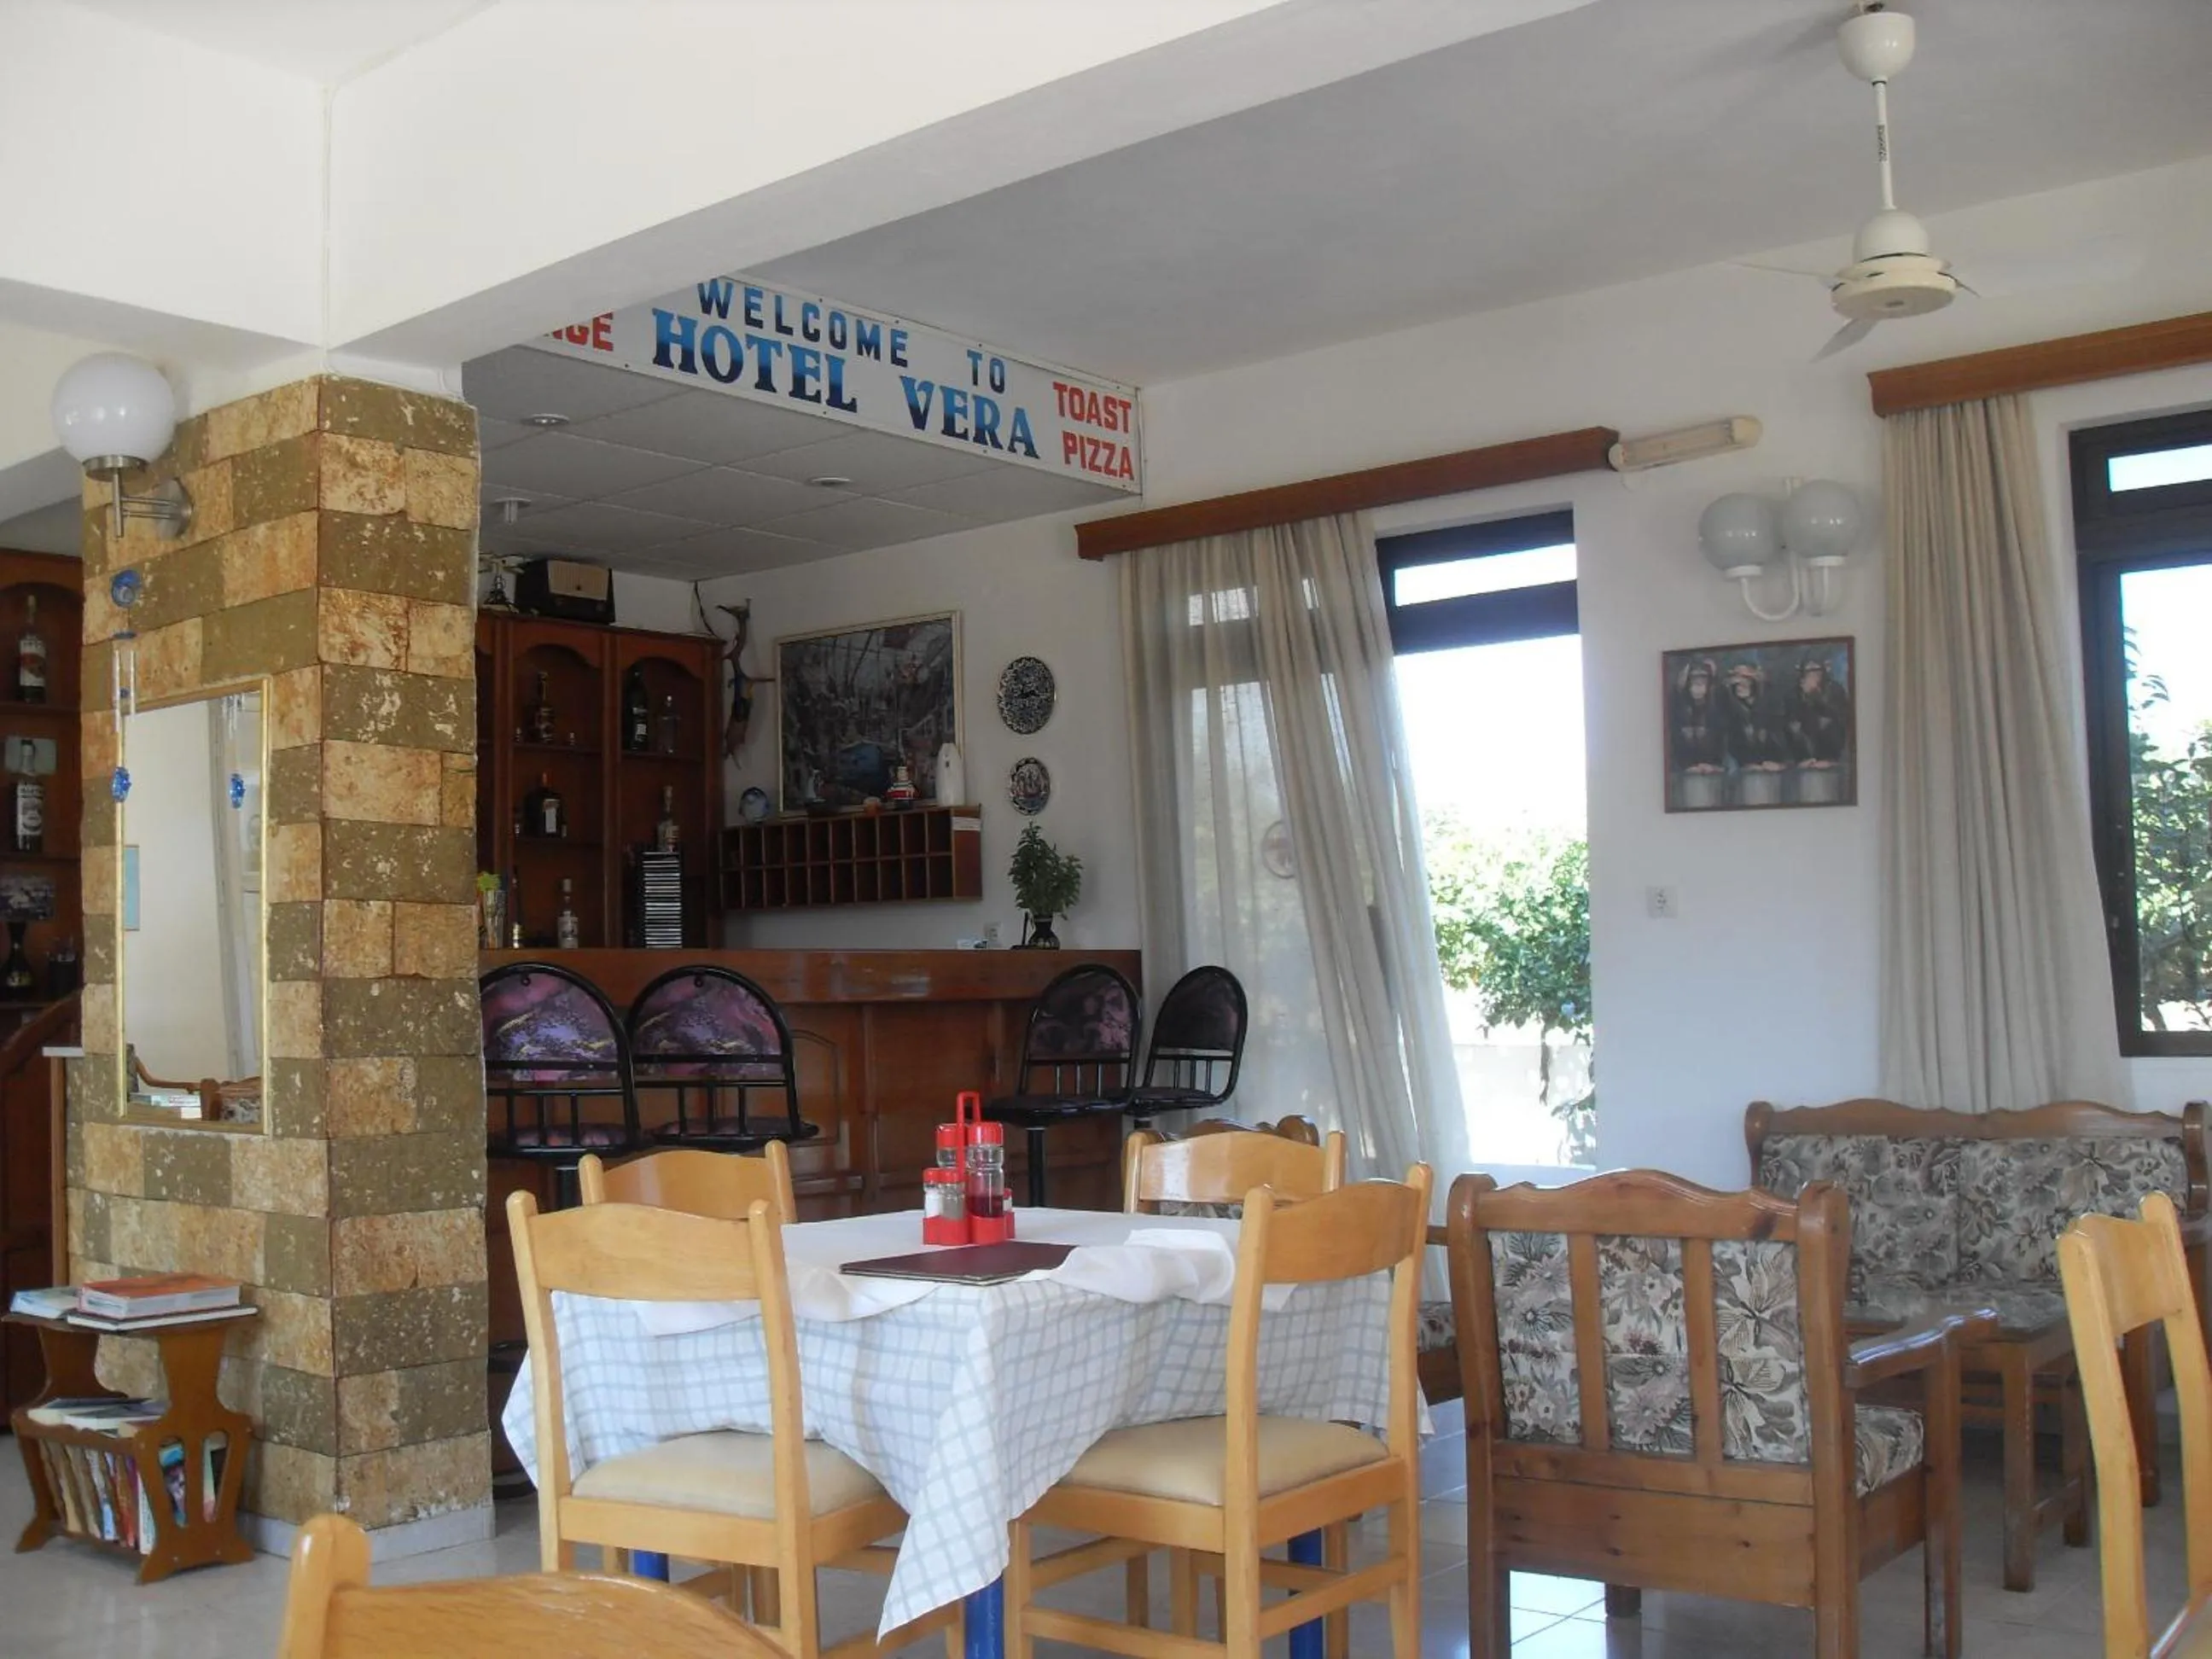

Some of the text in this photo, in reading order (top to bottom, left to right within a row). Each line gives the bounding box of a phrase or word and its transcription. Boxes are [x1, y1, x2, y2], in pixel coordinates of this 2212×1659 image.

[697, 277, 1005, 393] WELCOME TO
[652, 307, 1040, 459] HOTEL VERA
[1052, 381, 1132, 434] TOAST
[1062, 430, 1135, 481] PIZZA
